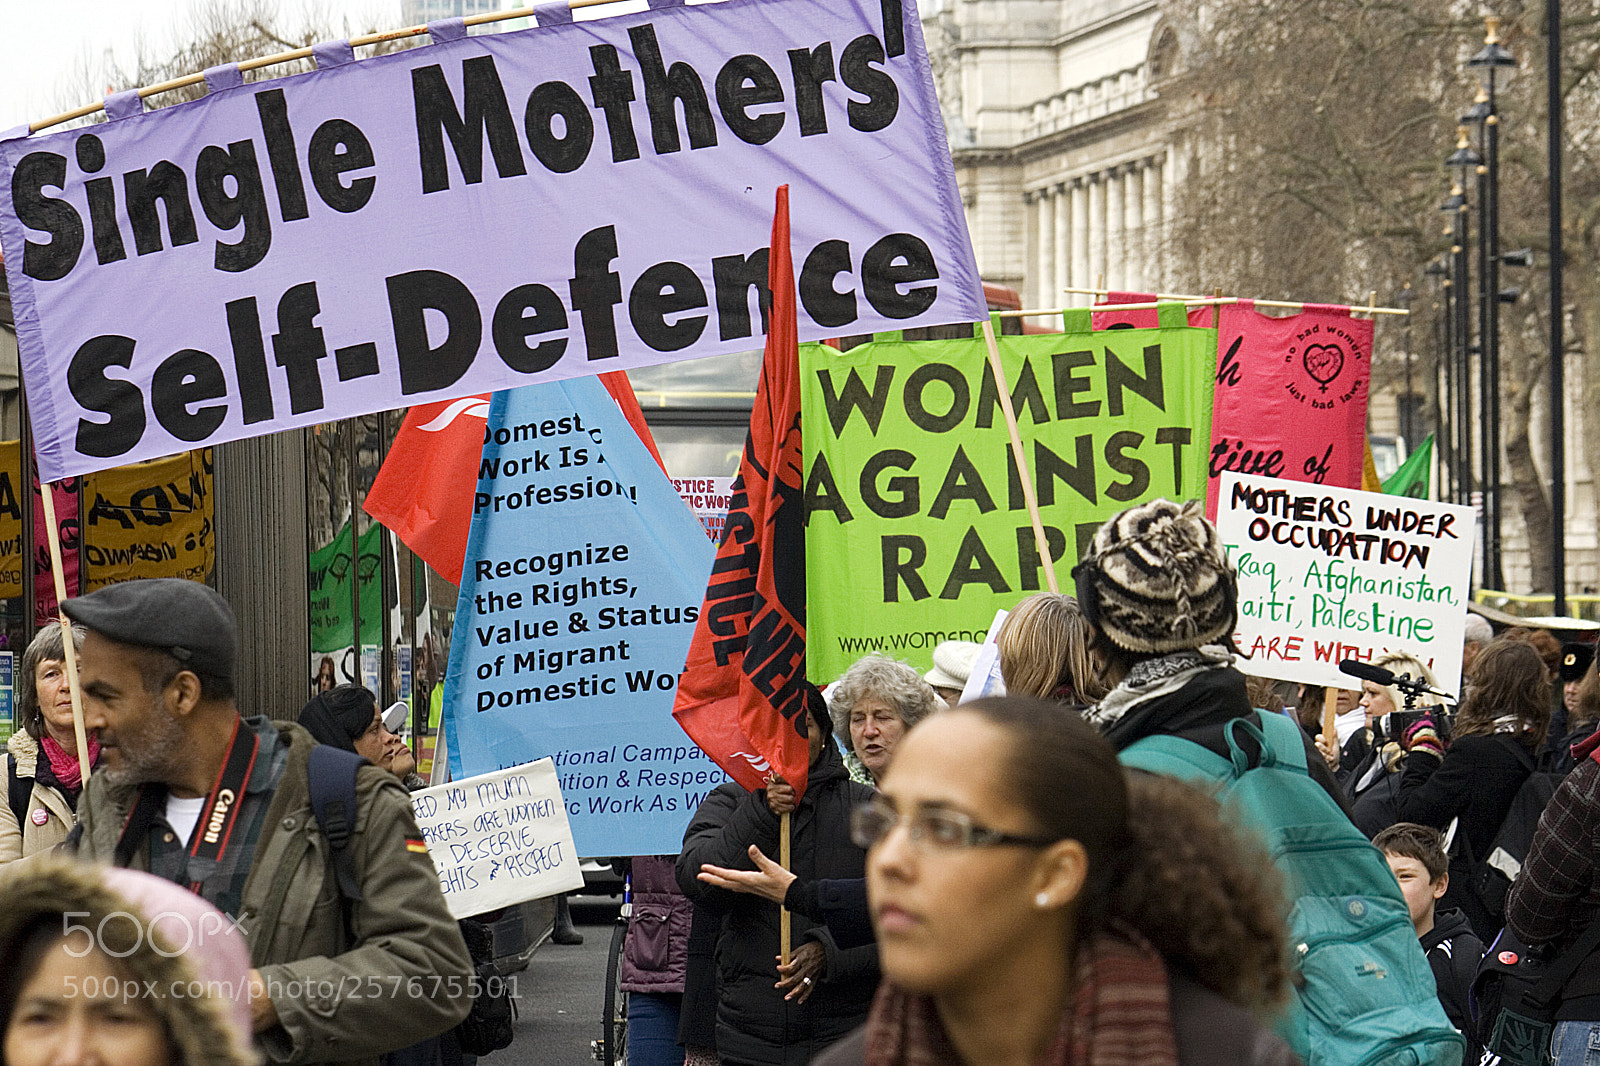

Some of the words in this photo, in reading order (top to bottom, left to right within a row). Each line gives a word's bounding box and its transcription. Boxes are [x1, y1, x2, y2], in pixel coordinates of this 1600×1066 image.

[12, 89, 376, 281] Single
[411, 0, 905, 194] Mothers'
[67, 224, 939, 458] Self-Defence
[1285, 347, 1296, 362] no
[1297, 324, 1319, 341] bad
[1327, 326, 1361, 360] women
[816, 344, 1166, 439] WOMEN
[1312, 399, 1334, 409] bad
[1340, 380, 1361, 403] laws
[484, 413, 602, 444] Domestc
[478, 450, 550, 480] Work
[559, 446, 588, 468] Is
[803, 427, 1191, 528] AGAINST
[1209, 438, 1285, 478] tive
[1304, 443, 1333, 484] of
[475, 476, 637, 514] Profession!
[670, 480, 715, 493] STICE
[705, 495, 732, 508] WOR
[1231, 482, 1352, 528] MOTHERS
[1366, 506, 1459, 539] UNDER
[475, 543, 629, 582] Recognize
[1249, 517, 1430, 570] OCCUPATION
[706, 464, 762, 668] USTICE
[1304, 560, 1459, 606] Afghanistan,
[475, 590, 522, 615] the
[532, 576, 638, 607] Rights,
[475, 620, 558, 647] Value
[568, 612, 590, 633] &
[598, 605, 699, 630] Status
[1237, 591, 1302, 628] aiti,
[1312, 594, 1435, 642] Palestine
[476, 656, 505, 680] of
[514, 640, 630, 675] Migrant
[1249, 635, 1304, 661] ARE
[1314, 641, 1373, 665] WITH
[477, 674, 616, 713] Domestic
[616, 770, 637, 788] &
[637, 769, 727, 790] Respect
[204, 789, 235, 843] Canon
[564, 798, 581, 815] ic
[588, 796, 644, 814] Work
[649, 794, 677, 812] As
[685, 792, 707, 810] W
[450, 826, 534, 864] DESERVE
[436, 865, 479, 894] GHTS
[504, 842, 564, 879] RESPECT
